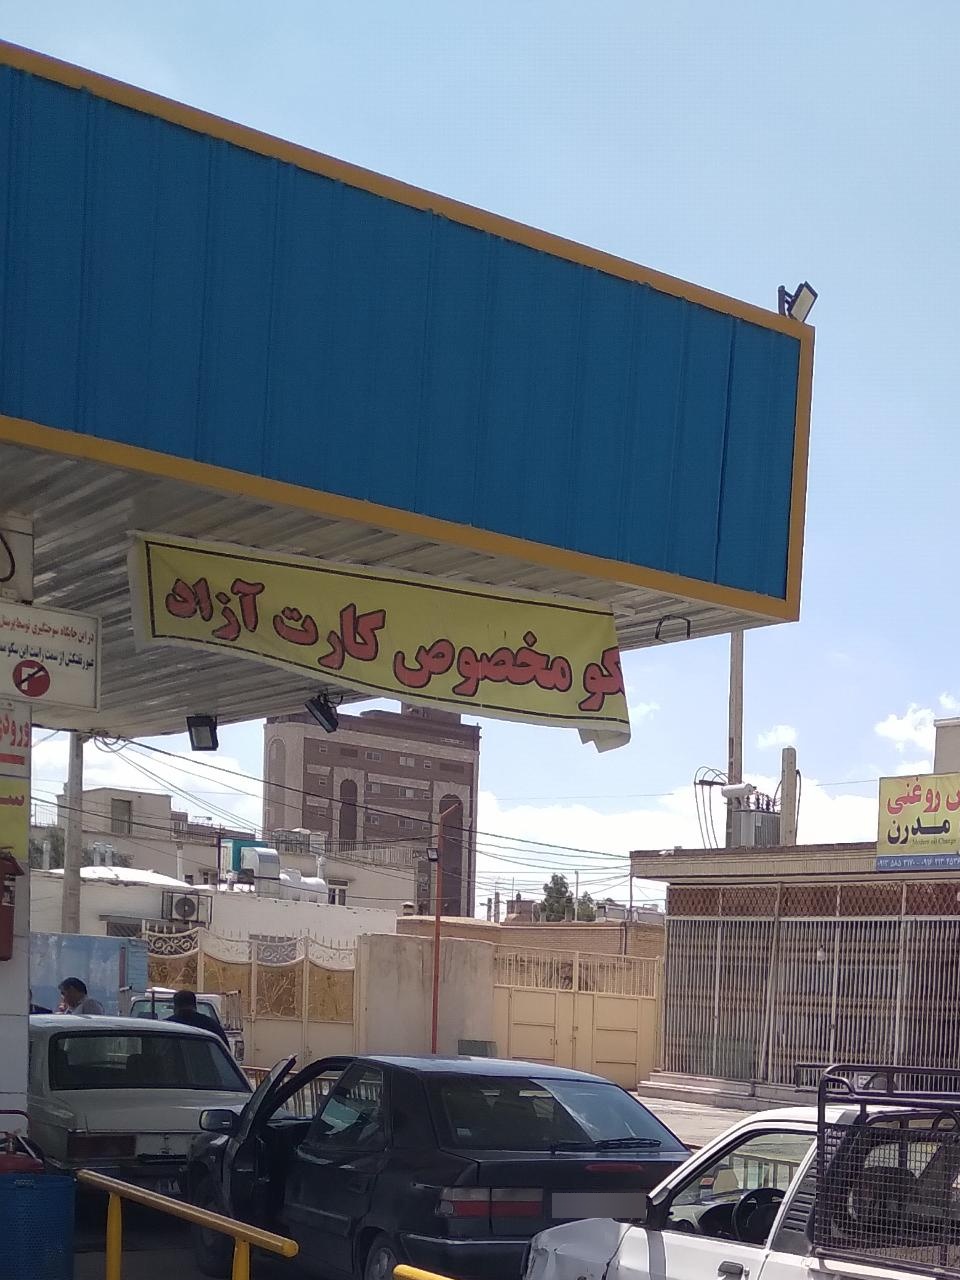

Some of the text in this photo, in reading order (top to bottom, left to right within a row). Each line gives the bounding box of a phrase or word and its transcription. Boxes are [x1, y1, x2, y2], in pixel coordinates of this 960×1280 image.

[165, 577, 626, 711] کو مخصوص کارت آزاد
[887, 816, 951, 845] مدرن
